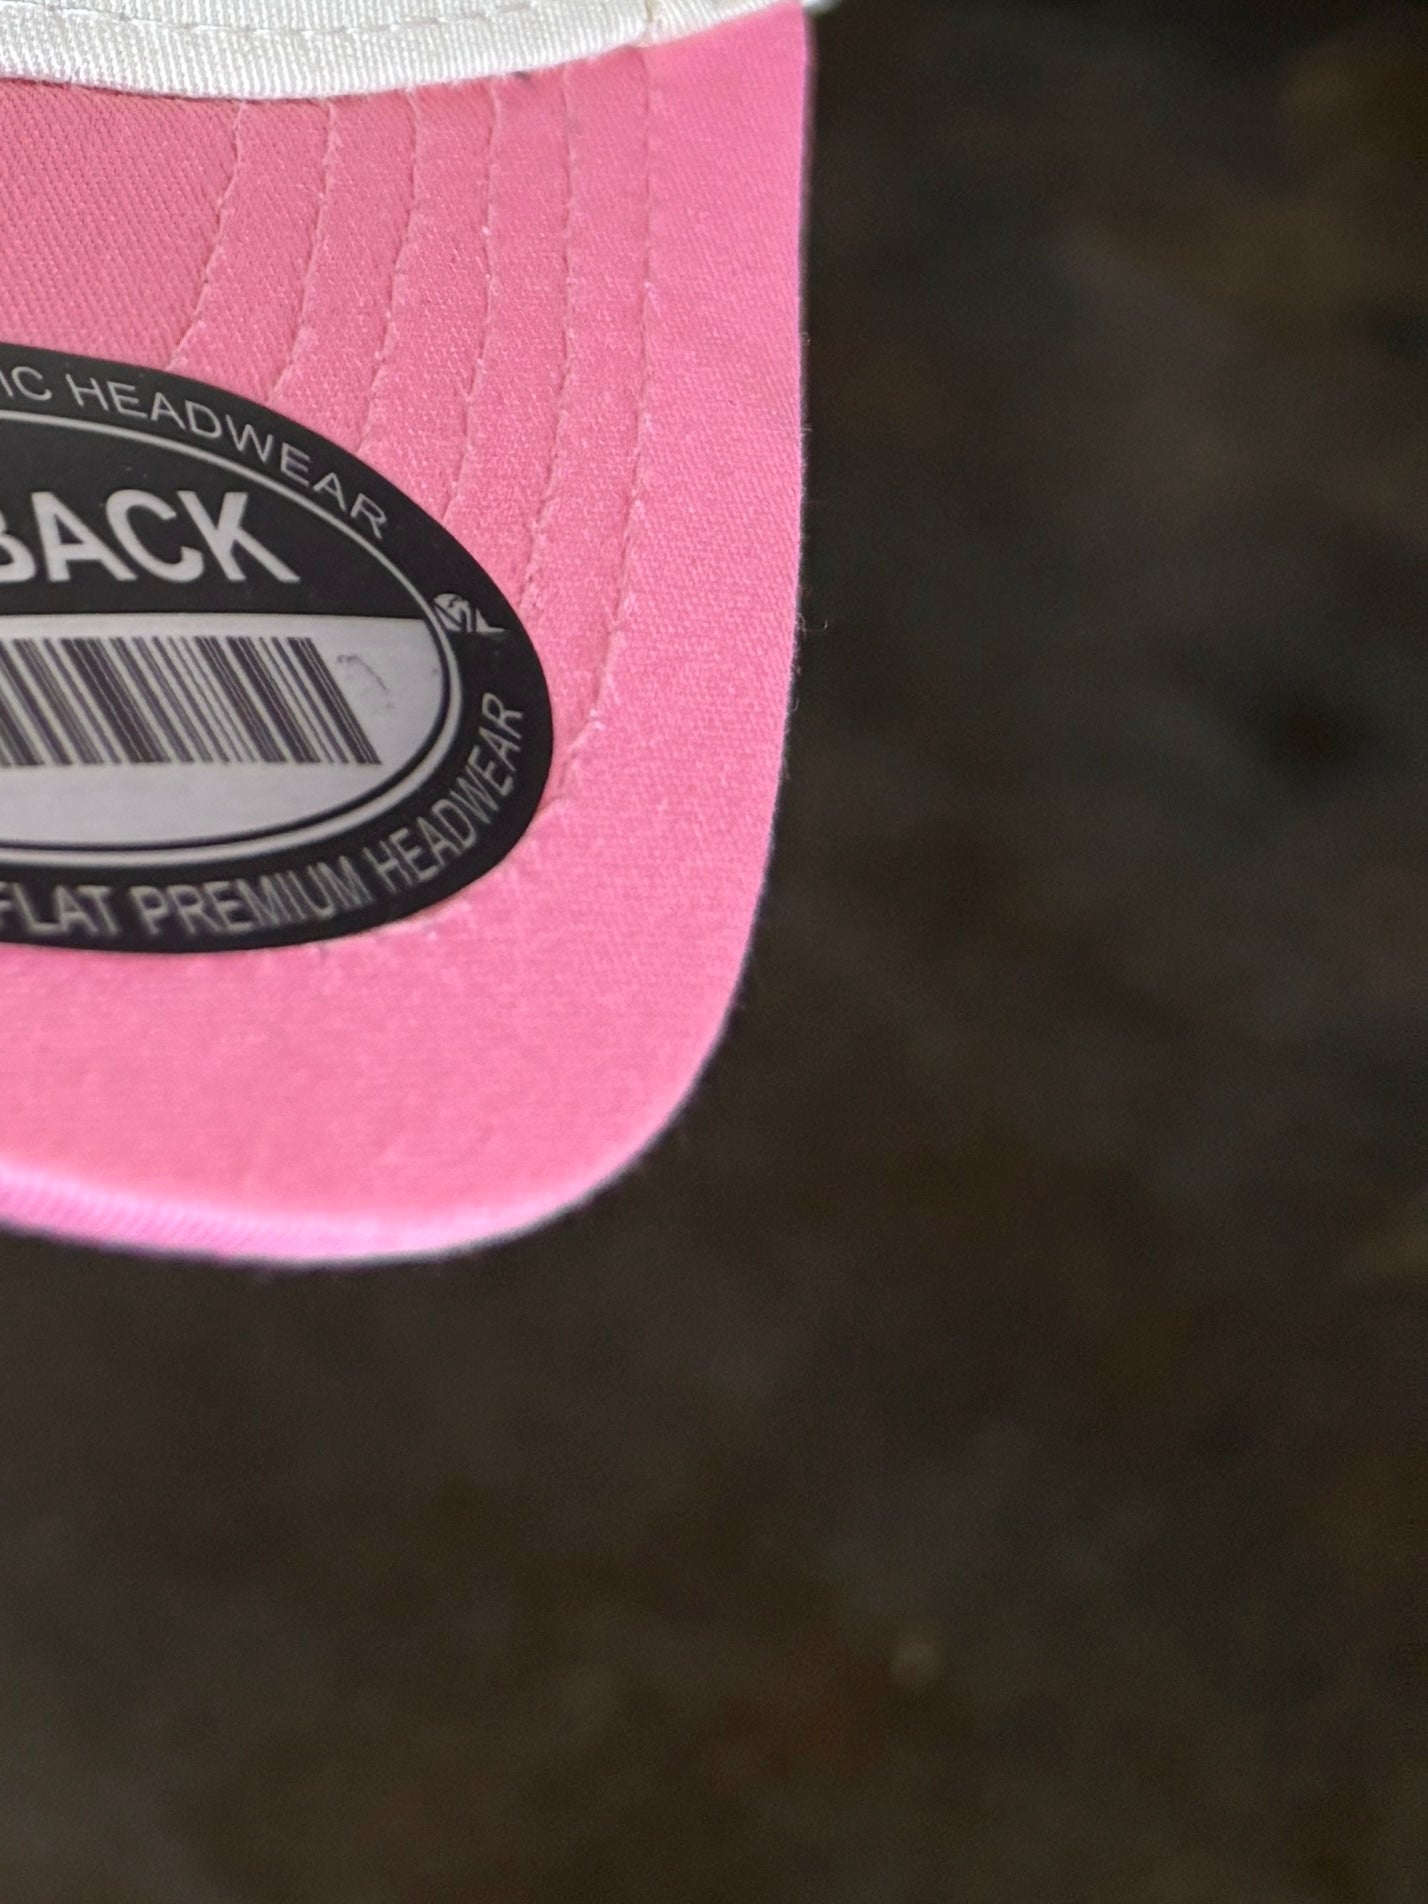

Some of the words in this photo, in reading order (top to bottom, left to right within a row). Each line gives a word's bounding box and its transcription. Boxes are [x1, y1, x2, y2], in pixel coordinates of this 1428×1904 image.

[66, 373, 389, 541] HEADWEAR
[130, 855, 375, 936] PREMIUM
[366, 692, 524, 895] HEADWEAR
